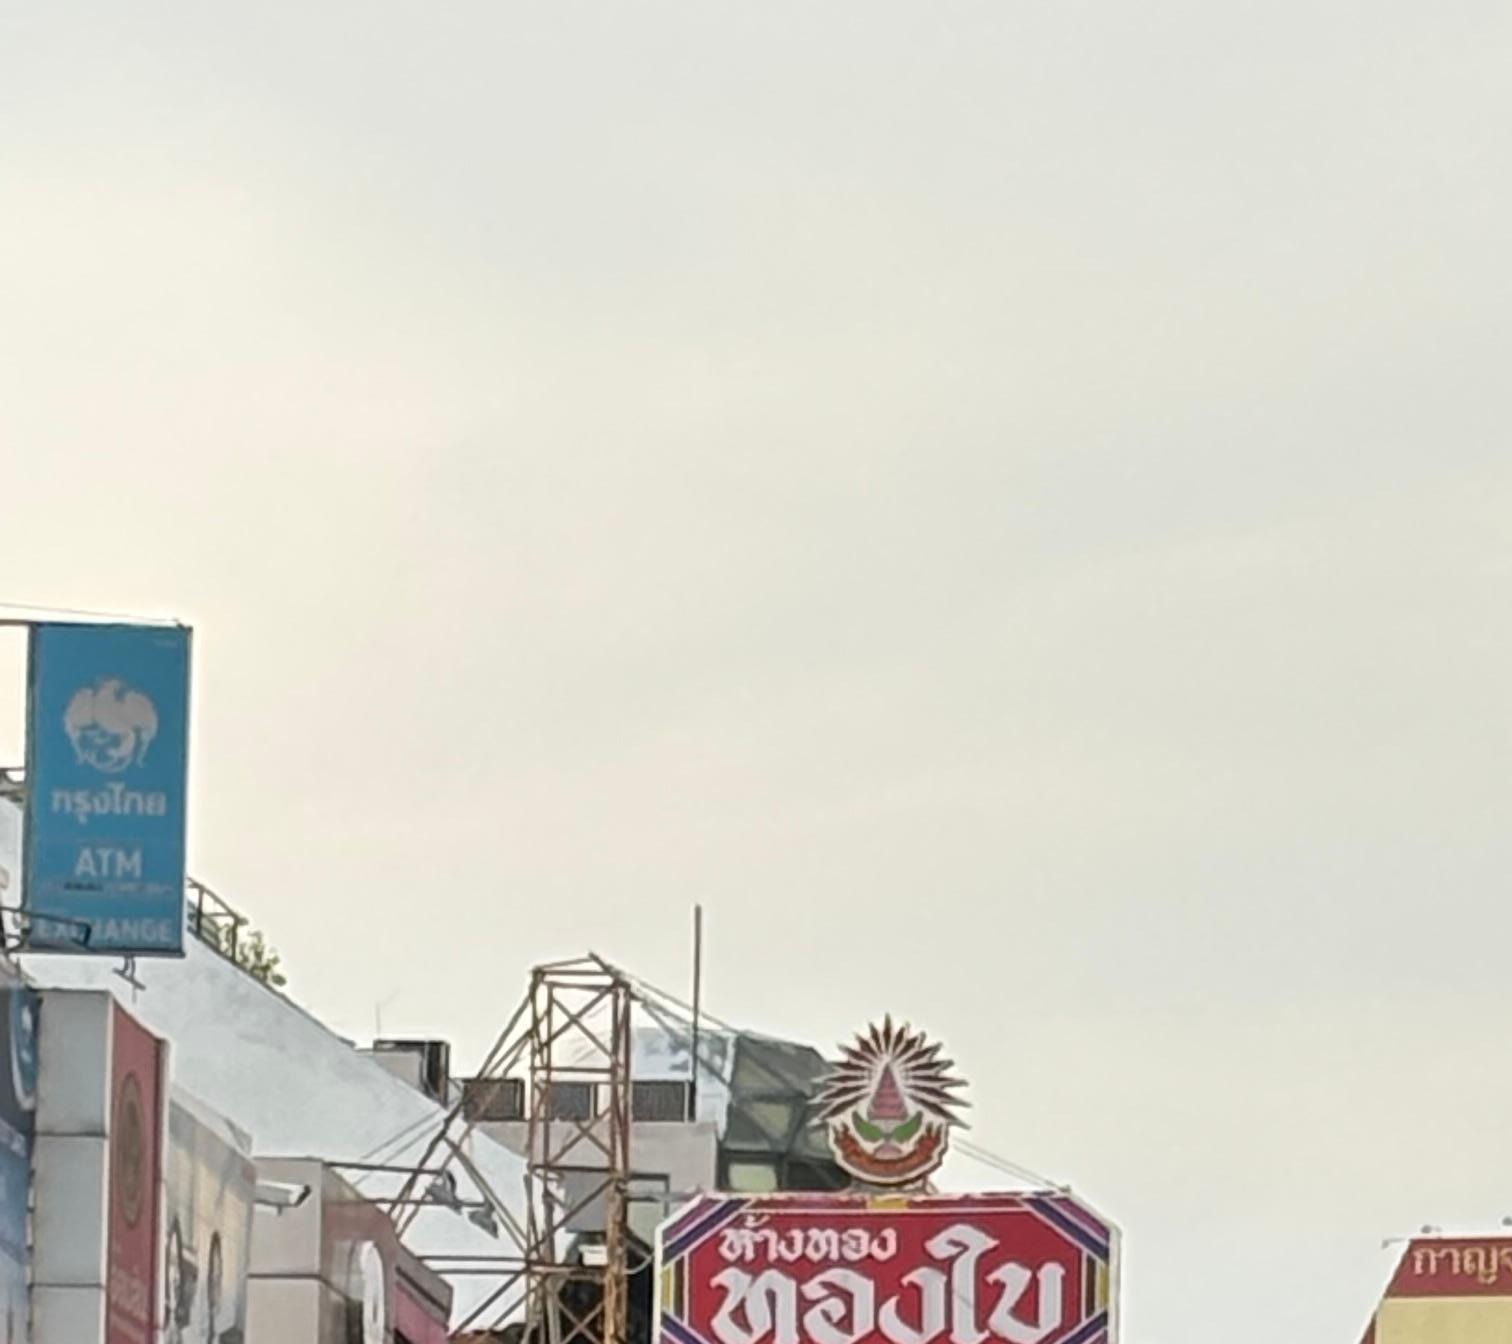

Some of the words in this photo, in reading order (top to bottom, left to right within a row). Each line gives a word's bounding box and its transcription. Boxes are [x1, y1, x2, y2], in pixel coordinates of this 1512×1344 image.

[74, 846, 142, 878] ATM
[719, 1214, 896, 1262] ห้างทอง
